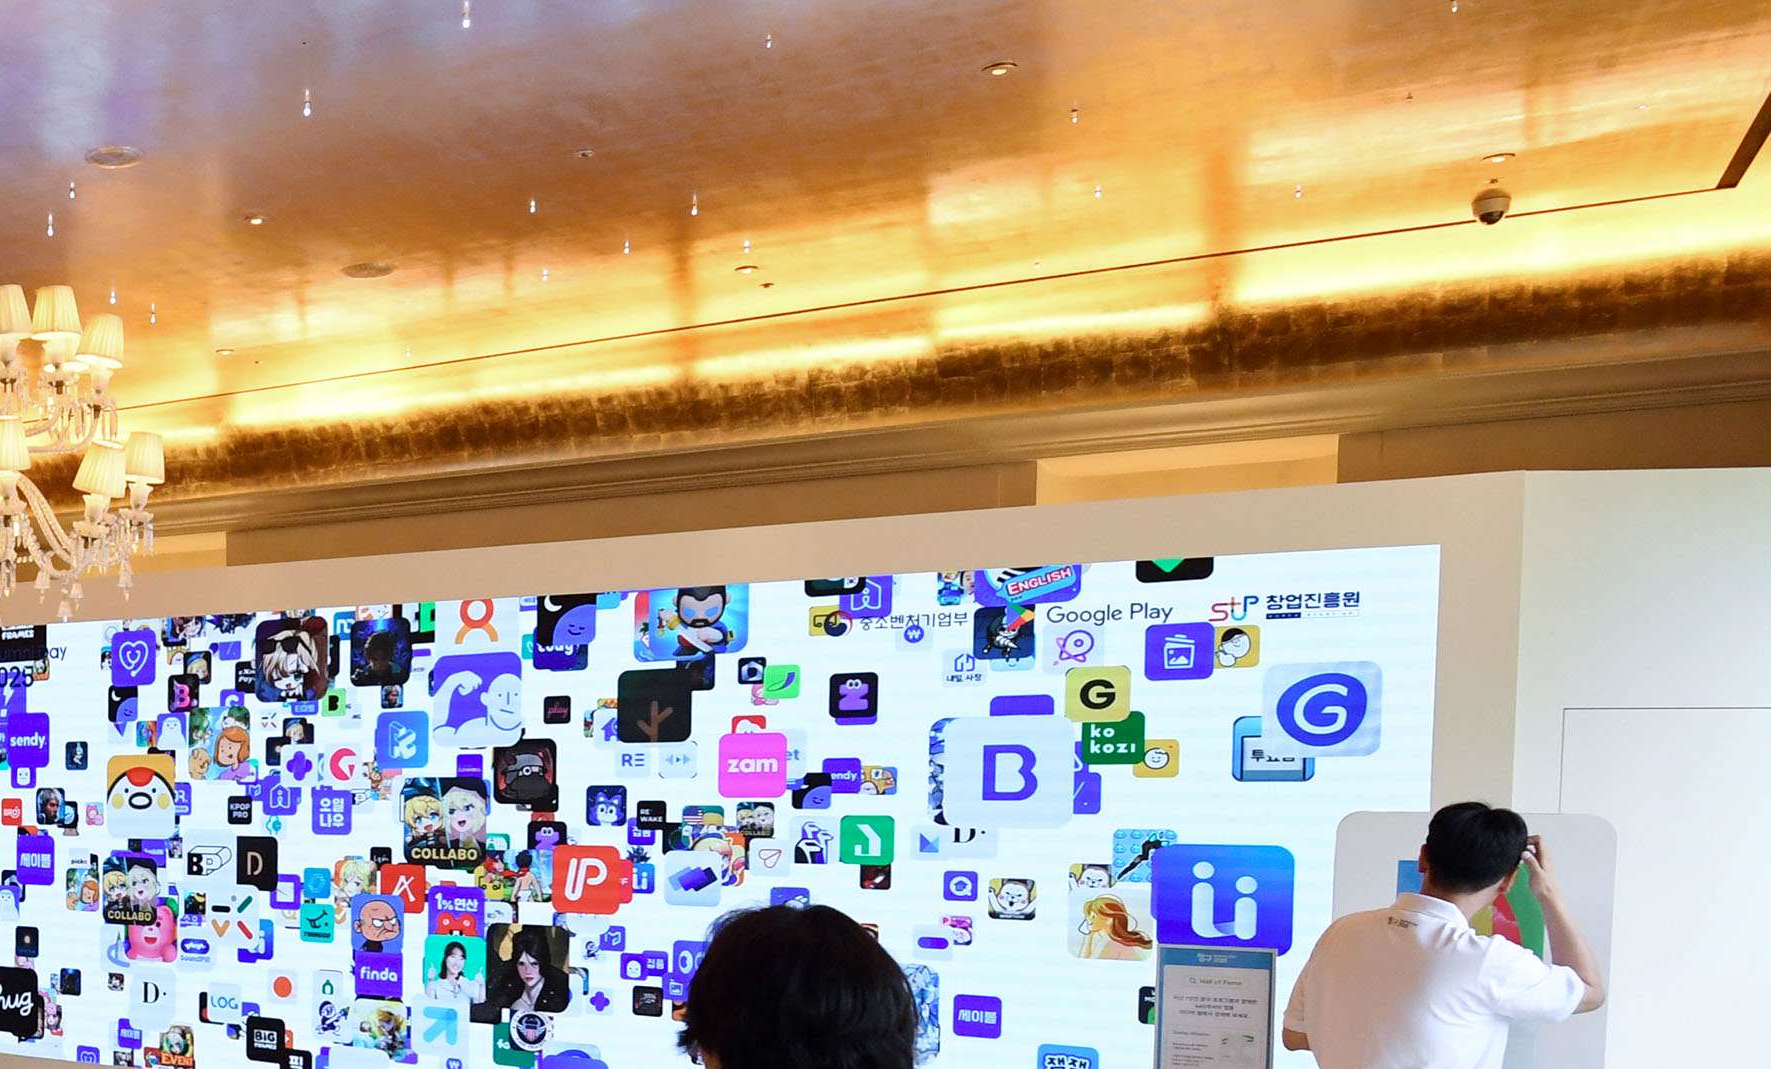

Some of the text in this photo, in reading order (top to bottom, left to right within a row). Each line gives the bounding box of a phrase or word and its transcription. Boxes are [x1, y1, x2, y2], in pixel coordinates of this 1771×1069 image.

[1007, 567, 1072, 596] ENGLISH
[1266, 591, 1360, 610] 창업진흥원
[860, 612, 968, 631] 중소벤처기업부
[1046, 602, 1174, 627] Google Play
[1080, 679, 1116, 710] G
[1293, 683, 1349, 735] G
[1090, 724, 1116, 738] ko
[728, 757, 778, 773] zam
[982, 744, 1039, 801] B
[233, 811, 249, 819] PRO
[319, 814, 344, 828] 나우
[412, 846, 478, 861] COLLABO
[435, 893, 479, 911] 1%연산
[107, 909, 152, 922] COLLABO
[360, 966, 398, 983] finda
